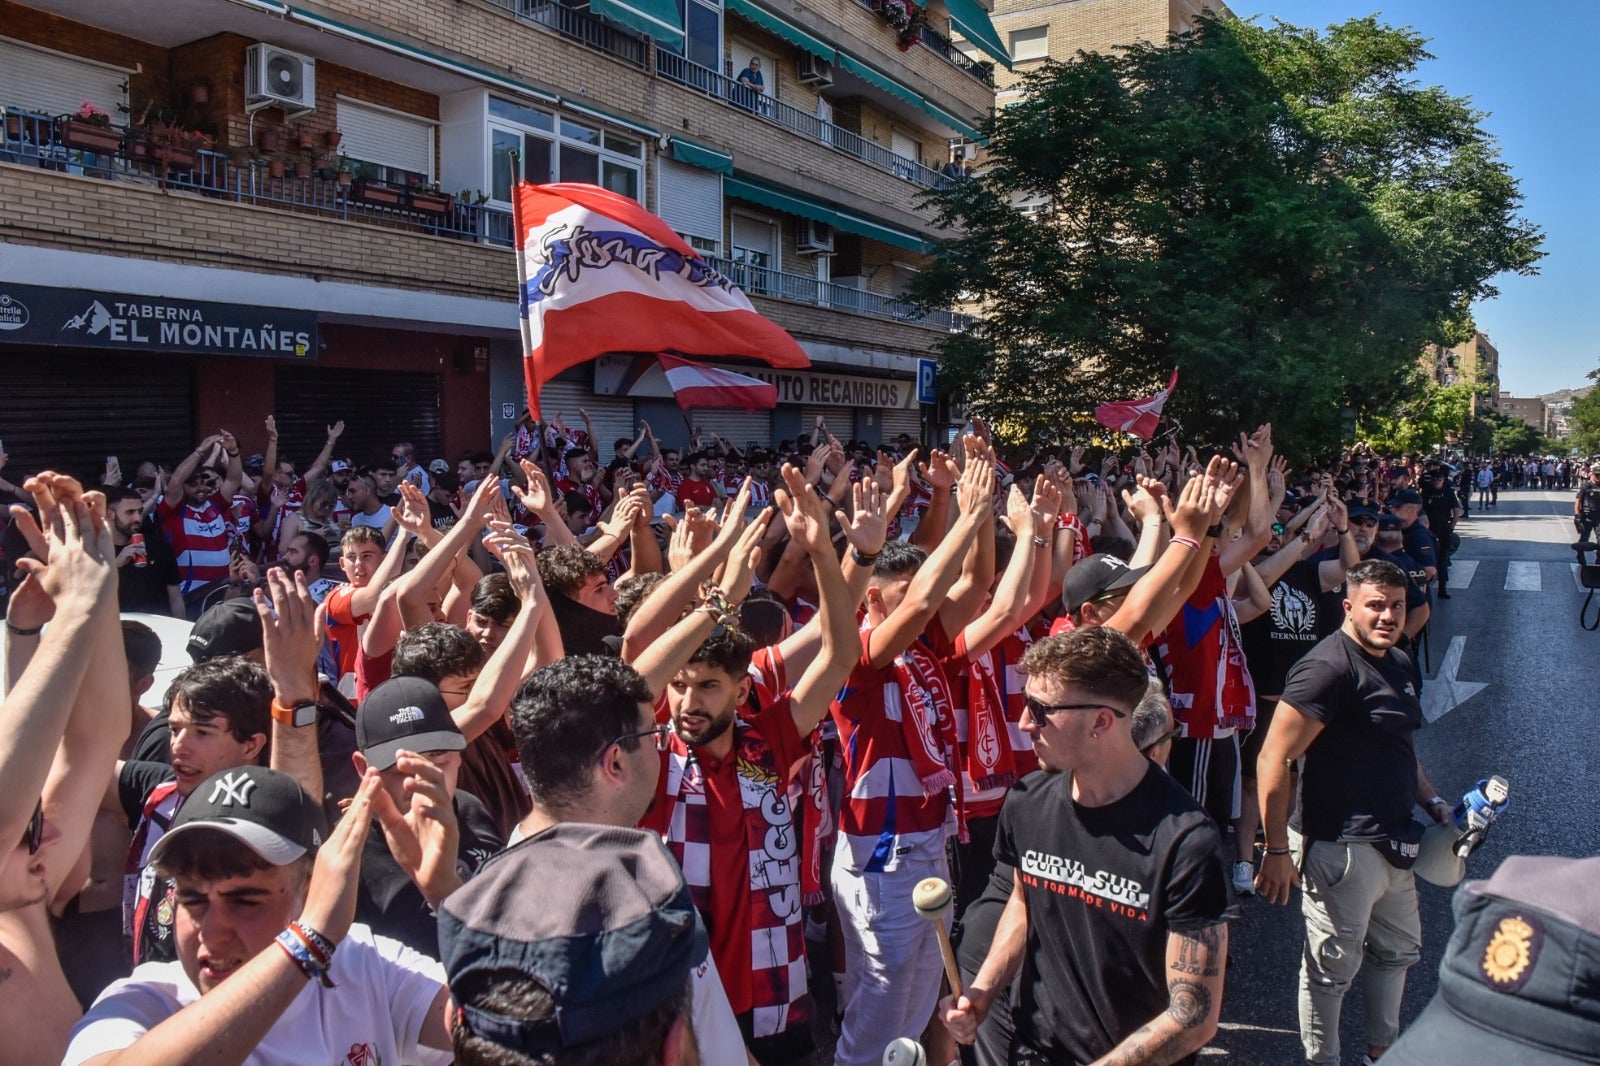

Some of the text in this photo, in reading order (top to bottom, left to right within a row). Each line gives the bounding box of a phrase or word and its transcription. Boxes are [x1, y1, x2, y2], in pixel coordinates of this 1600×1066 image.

[0, 306, 21, 314] trella
[0, 314, 20, 322] alicia
[115, 302, 203, 322] TABERNA
[109, 318, 311, 352] EL MONTAÑES
[810, 376, 898, 407] RECAMBIOS
[922, 365, 934, 397] P
[208, 772, 255, 806] NY
[1025, 850, 1142, 903] CURVA SUR
[1044, 881, 1086, 900] FORMA
[1086, 896, 1103, 908] DE
[1110, 904, 1147, 921] VIDA
